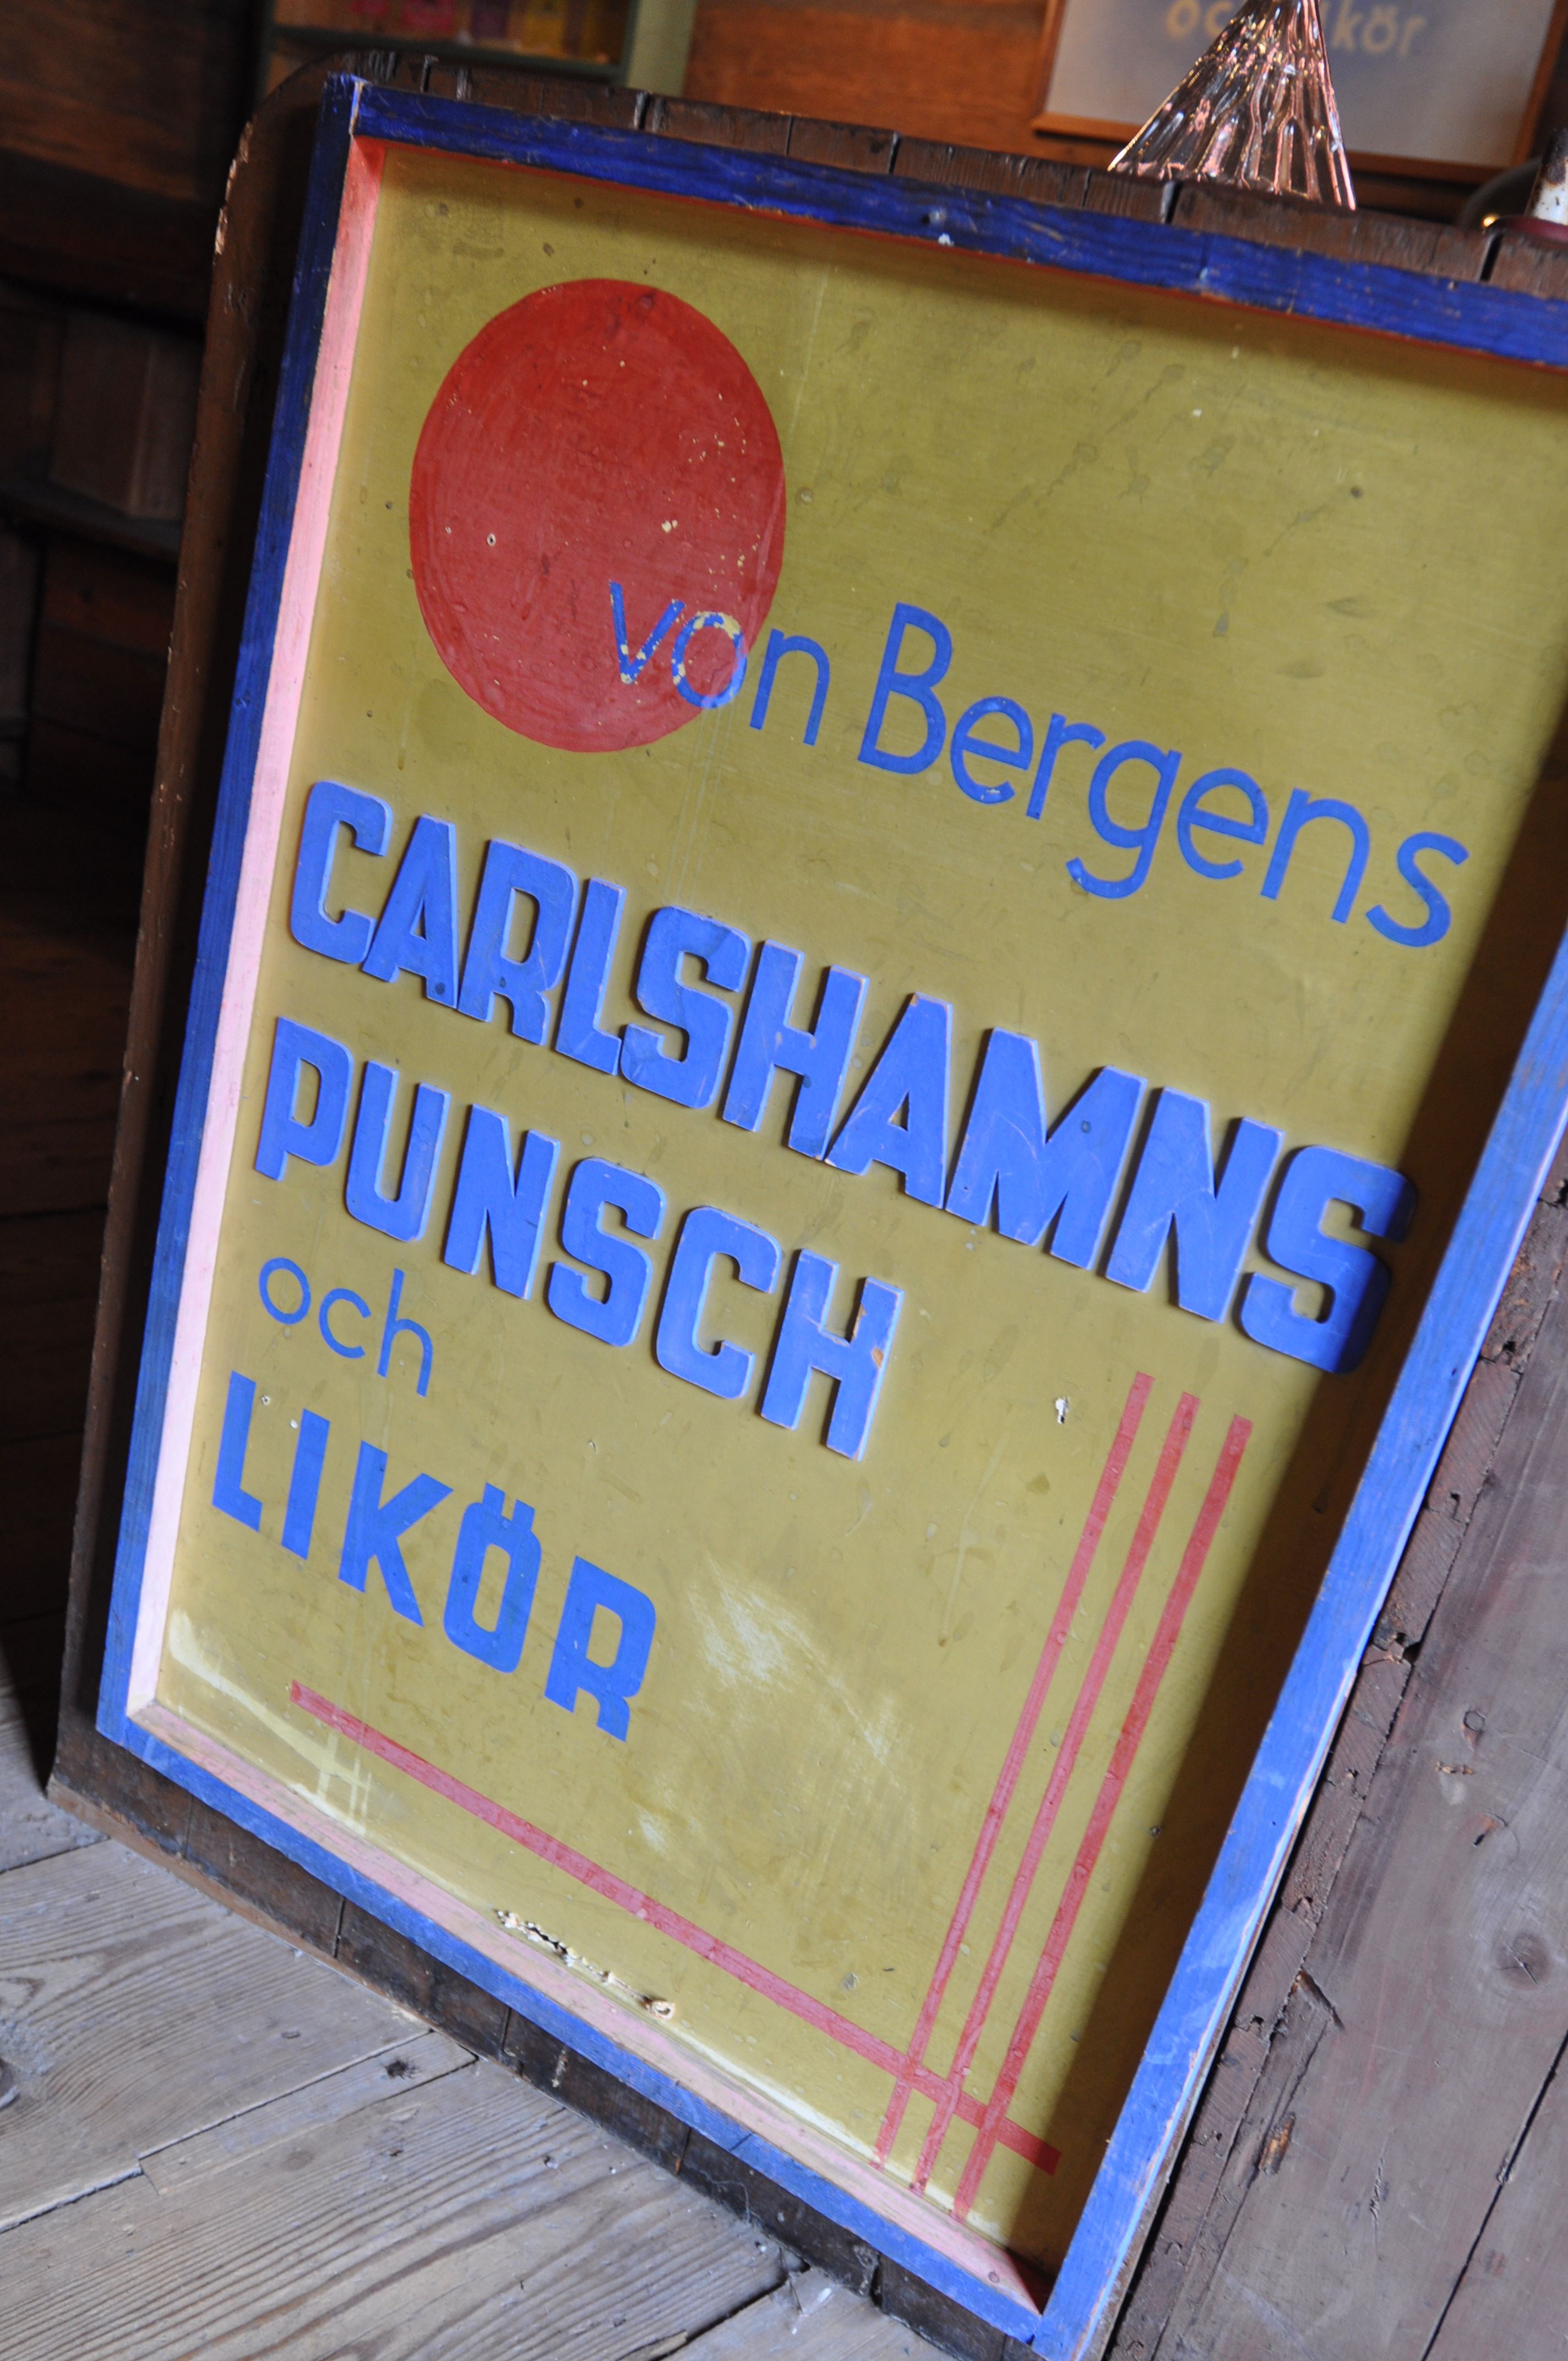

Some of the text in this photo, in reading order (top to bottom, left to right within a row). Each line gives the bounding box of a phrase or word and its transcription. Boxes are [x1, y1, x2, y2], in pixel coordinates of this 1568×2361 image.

[608, 581, 1471, 948] von Bergens
[255, 1017, 905, 1461] PUNSCH
[290, 781, 1417, 1373] CARLSHAMNS
[259, 1256, 433, 1397] och
[213, 1371, 656, 1743] LIKÖR
